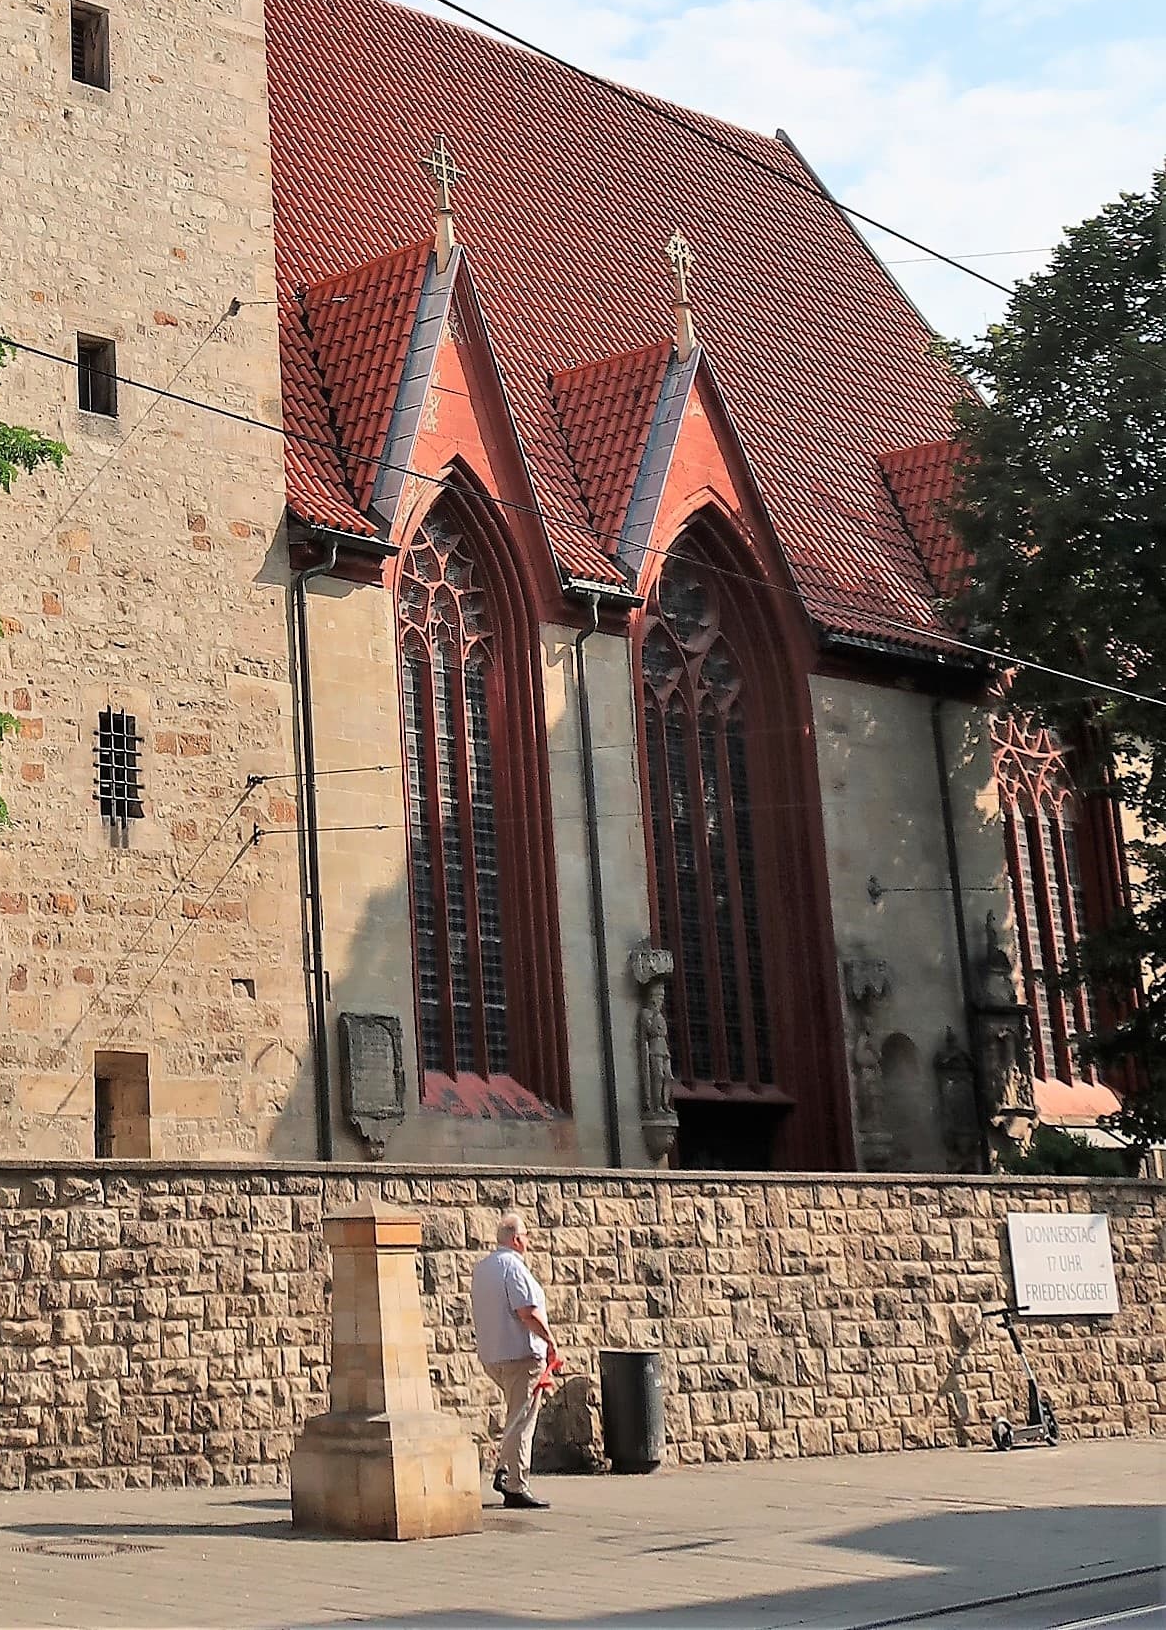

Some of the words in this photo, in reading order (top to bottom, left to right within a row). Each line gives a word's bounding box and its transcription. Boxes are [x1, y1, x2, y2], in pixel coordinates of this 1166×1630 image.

[1025, 1226, 1097, 1243] DONNERSTAG
[1047, 1256, 1056, 1272] 17
[1059, 1255, 1083, 1272] UHR
[1025, 1283, 1108, 1301] FRIEDENSGEBET
